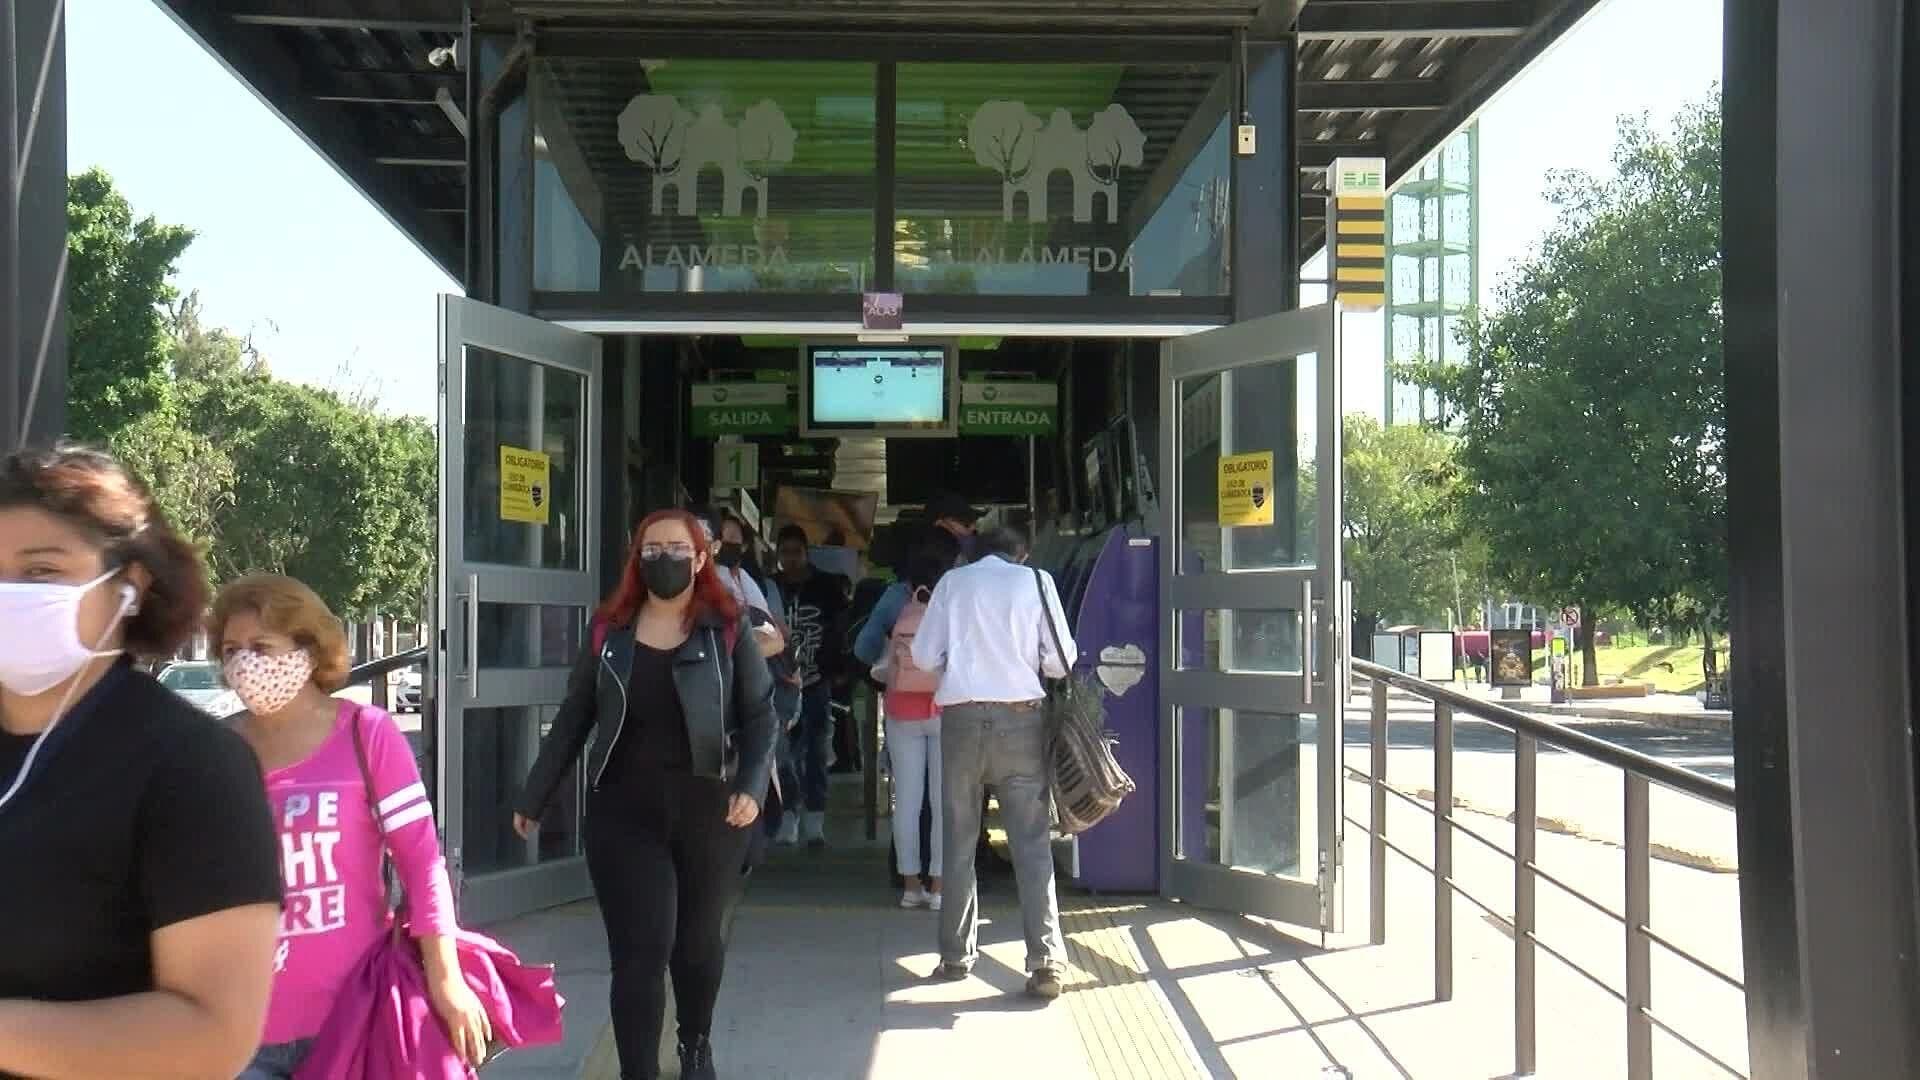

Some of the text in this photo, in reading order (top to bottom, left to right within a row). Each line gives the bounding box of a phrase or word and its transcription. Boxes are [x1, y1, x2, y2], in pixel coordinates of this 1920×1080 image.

[1344, 173, 1381, 186] EJE
[618, 243, 793, 271] ALAMEDA
[708, 411, 772, 426] SALIDA
[967, 410, 1051, 425] ENTRADA
[728, 450, 742, 481] 1
[1223, 459, 1268, 473] OBLIGATORIO
